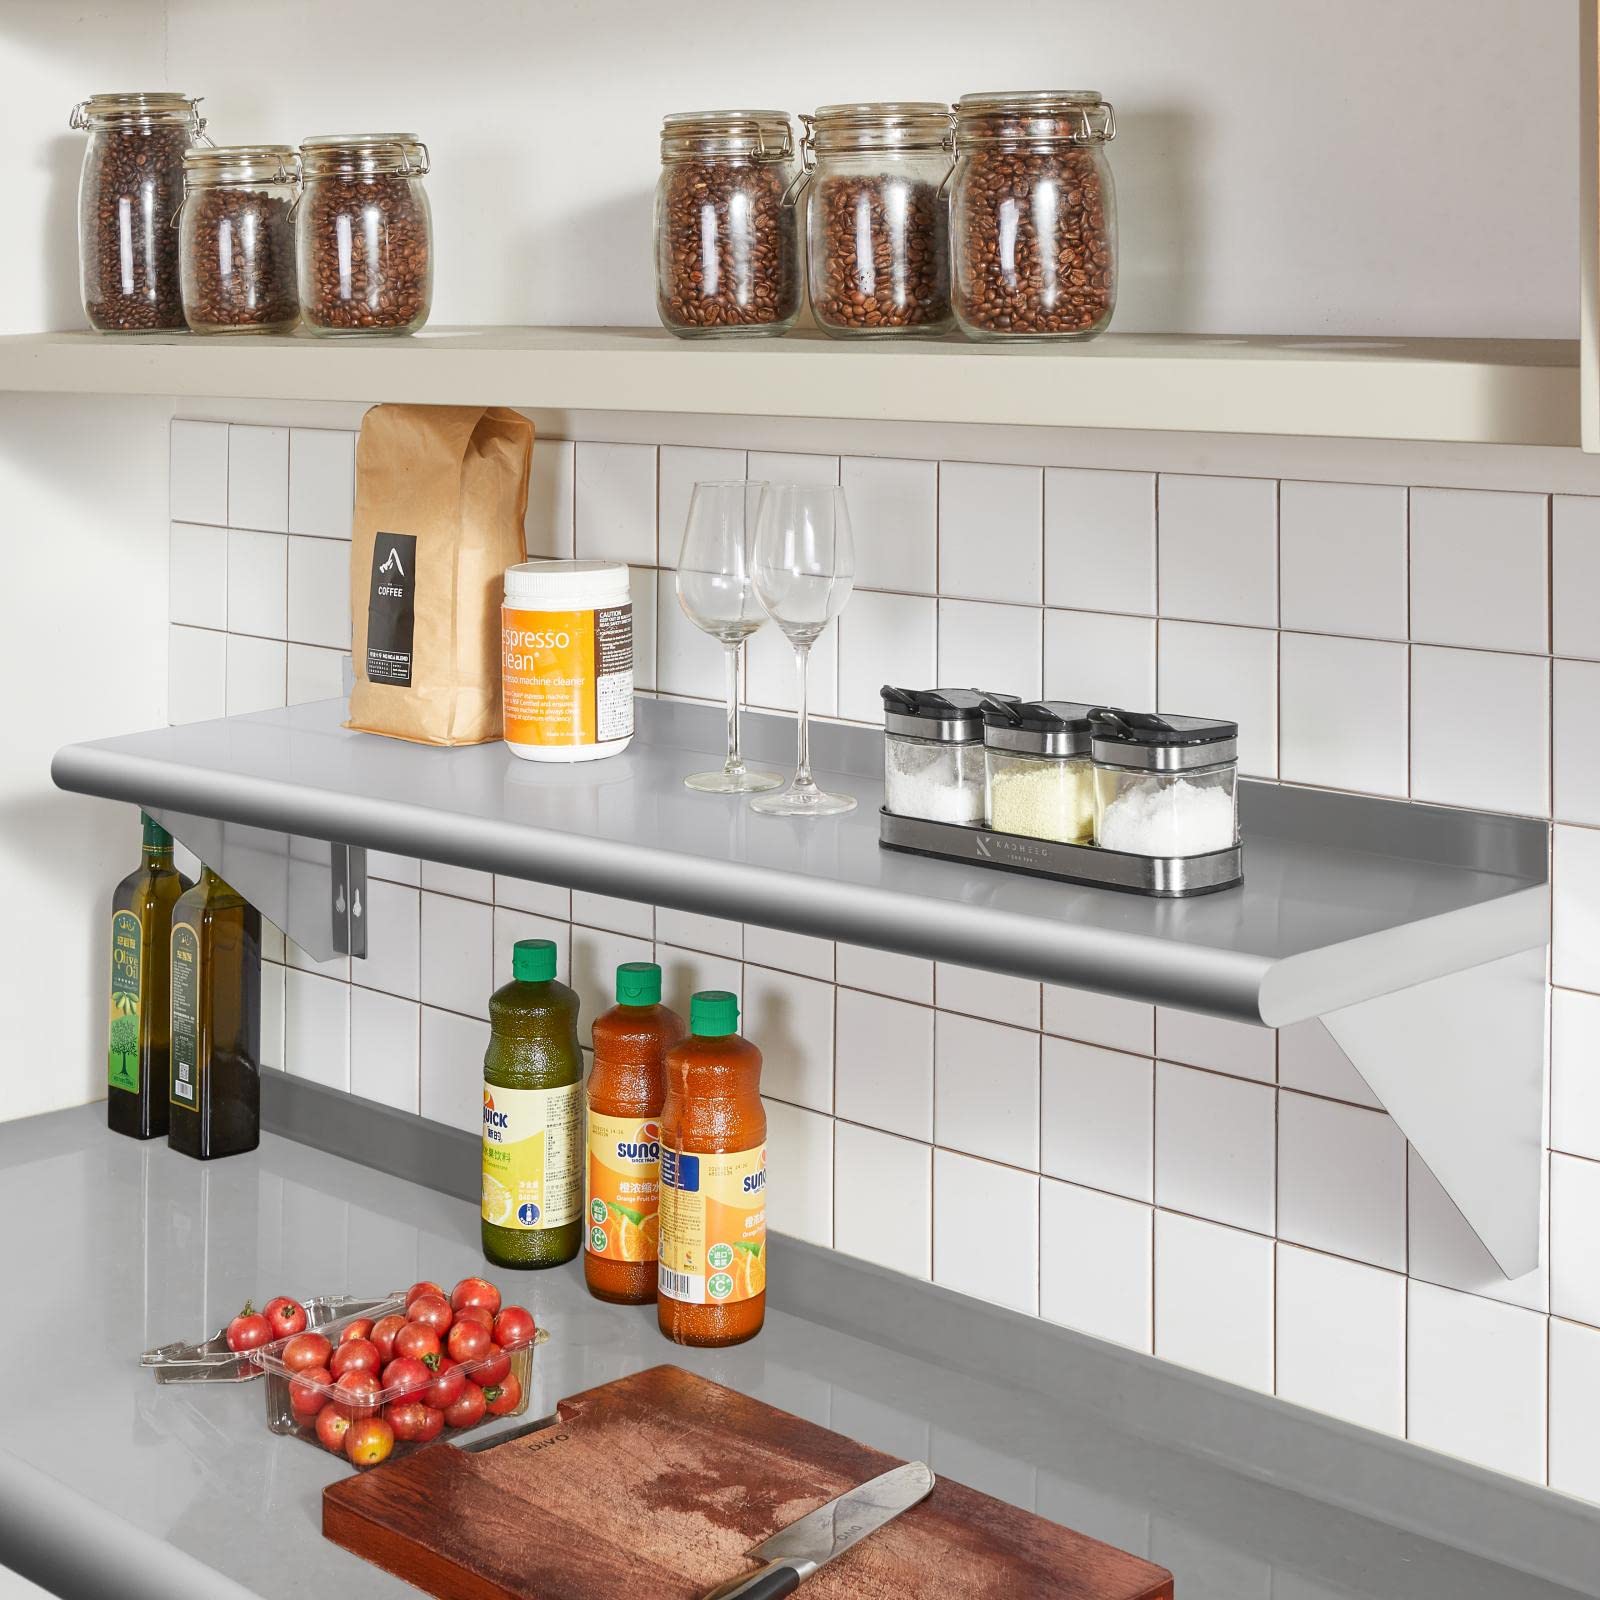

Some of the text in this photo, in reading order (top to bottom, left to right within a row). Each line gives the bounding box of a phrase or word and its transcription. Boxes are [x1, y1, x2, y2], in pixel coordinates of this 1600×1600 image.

[378, 586, 403, 598] COFFEE
[600, 610, 621, 618] CAUTION
[519, 676, 552, 686] machine
[553, 676, 585, 687] cleaner
[113, 948, 139, 968] Olive
[125, 964, 139, 979] Oil
[616, 1194, 636, 1204] Orange
[715, 1279, 726, 1293] C
